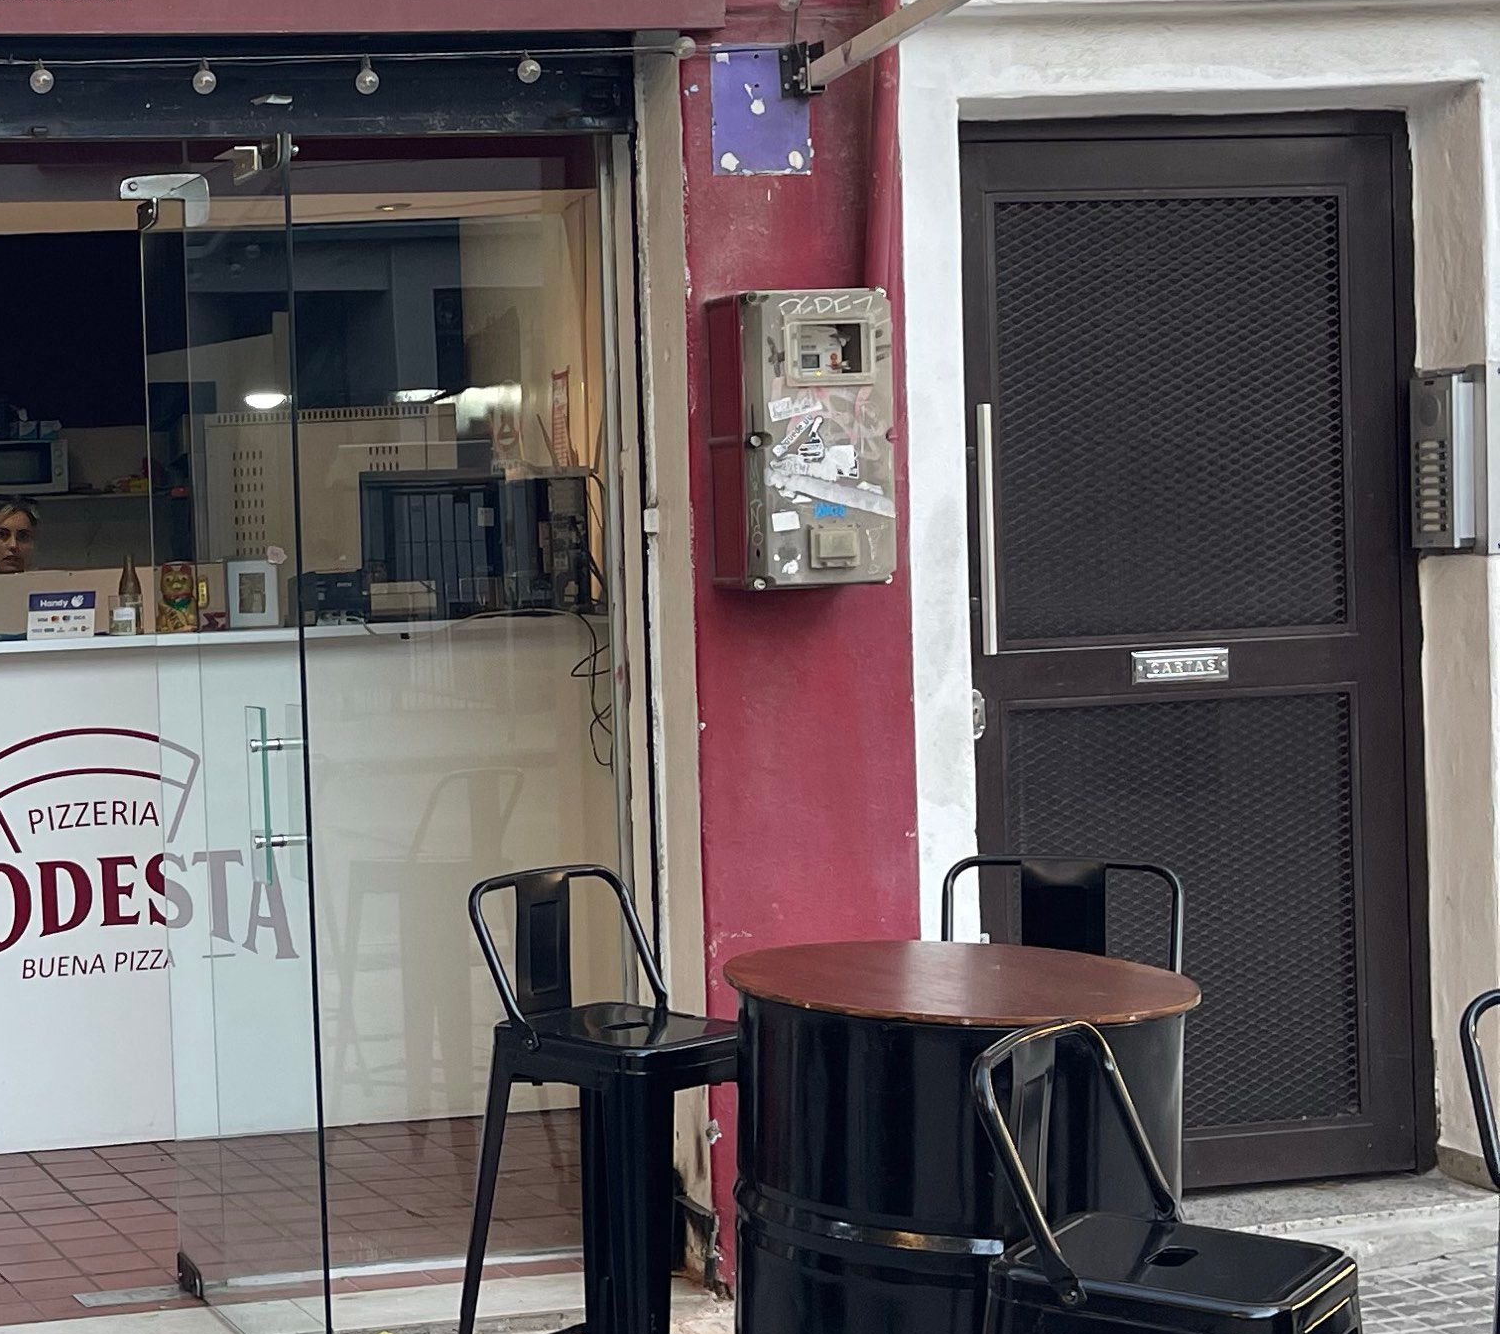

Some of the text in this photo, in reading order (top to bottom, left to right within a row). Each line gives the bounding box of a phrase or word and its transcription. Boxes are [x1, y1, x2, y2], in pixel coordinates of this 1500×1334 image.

[40, 599, 69, 608] Handy
[1150, 659, 1217, 674] CARTAS
[28, 800, 160, 835] PIZZERIA
[22, 949, 176, 980] BUENA PIZZA
